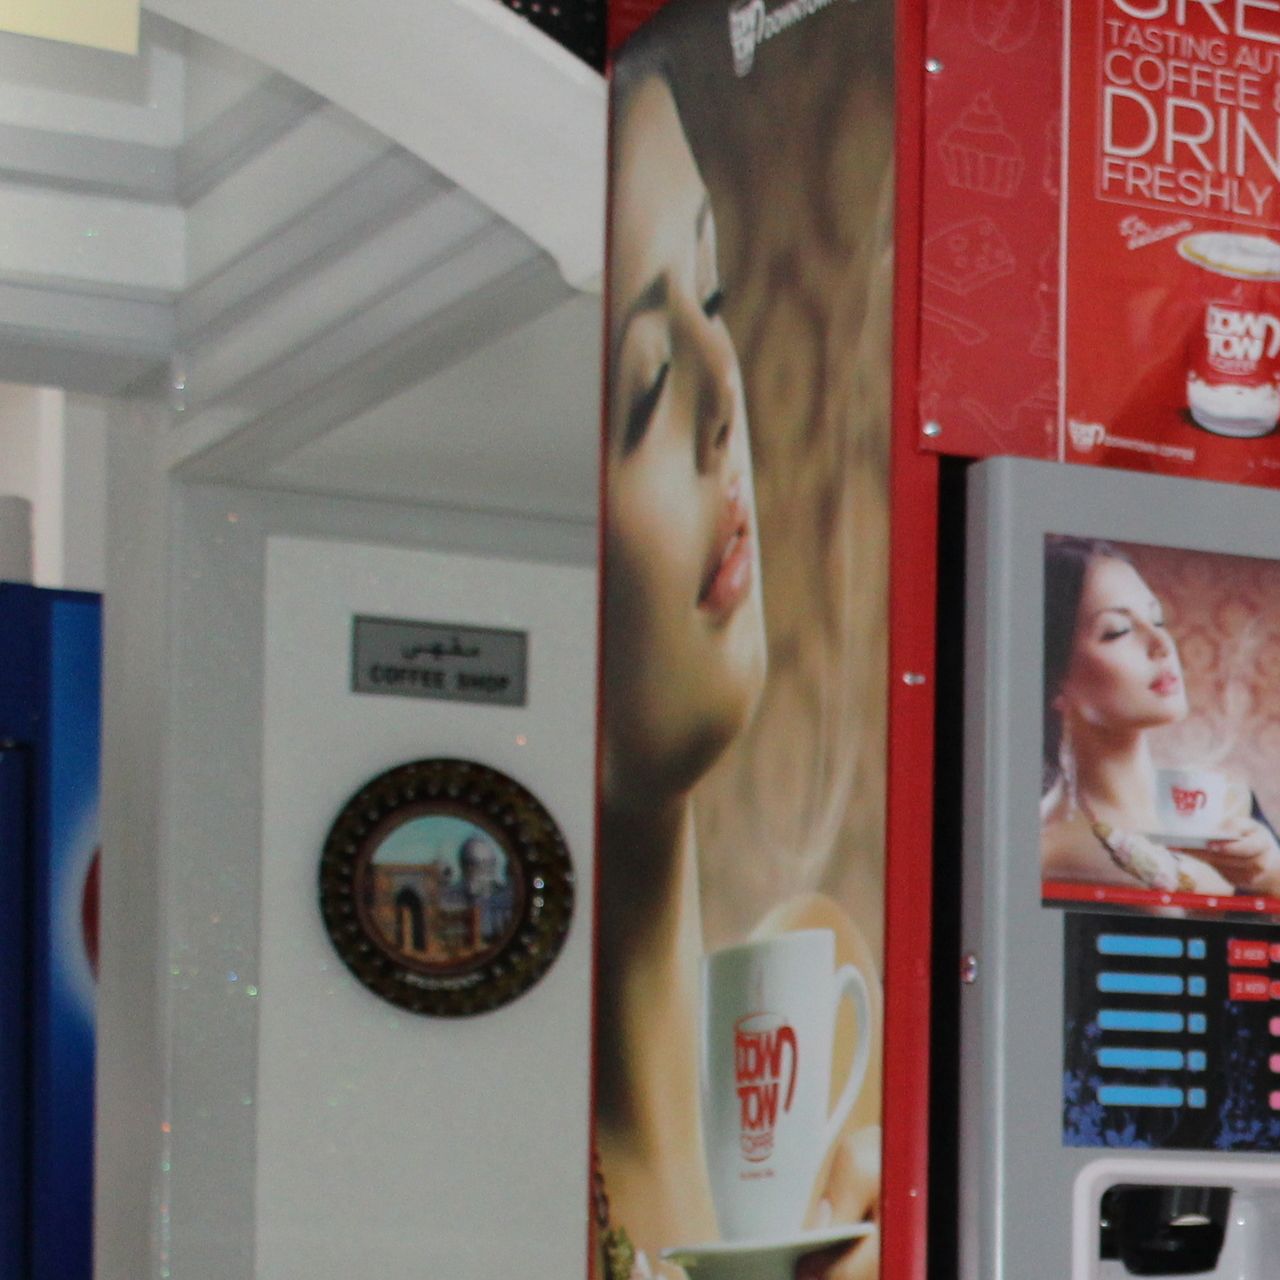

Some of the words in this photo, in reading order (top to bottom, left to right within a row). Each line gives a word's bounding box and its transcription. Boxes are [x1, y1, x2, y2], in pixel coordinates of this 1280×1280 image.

[1106, 19, 1228, 65] TASTING
[1104, 50, 1262, 110] COFFEE
[1103, 156, 1272, 216] FRESHLY
[369, 662, 446, 690] COFFEE
